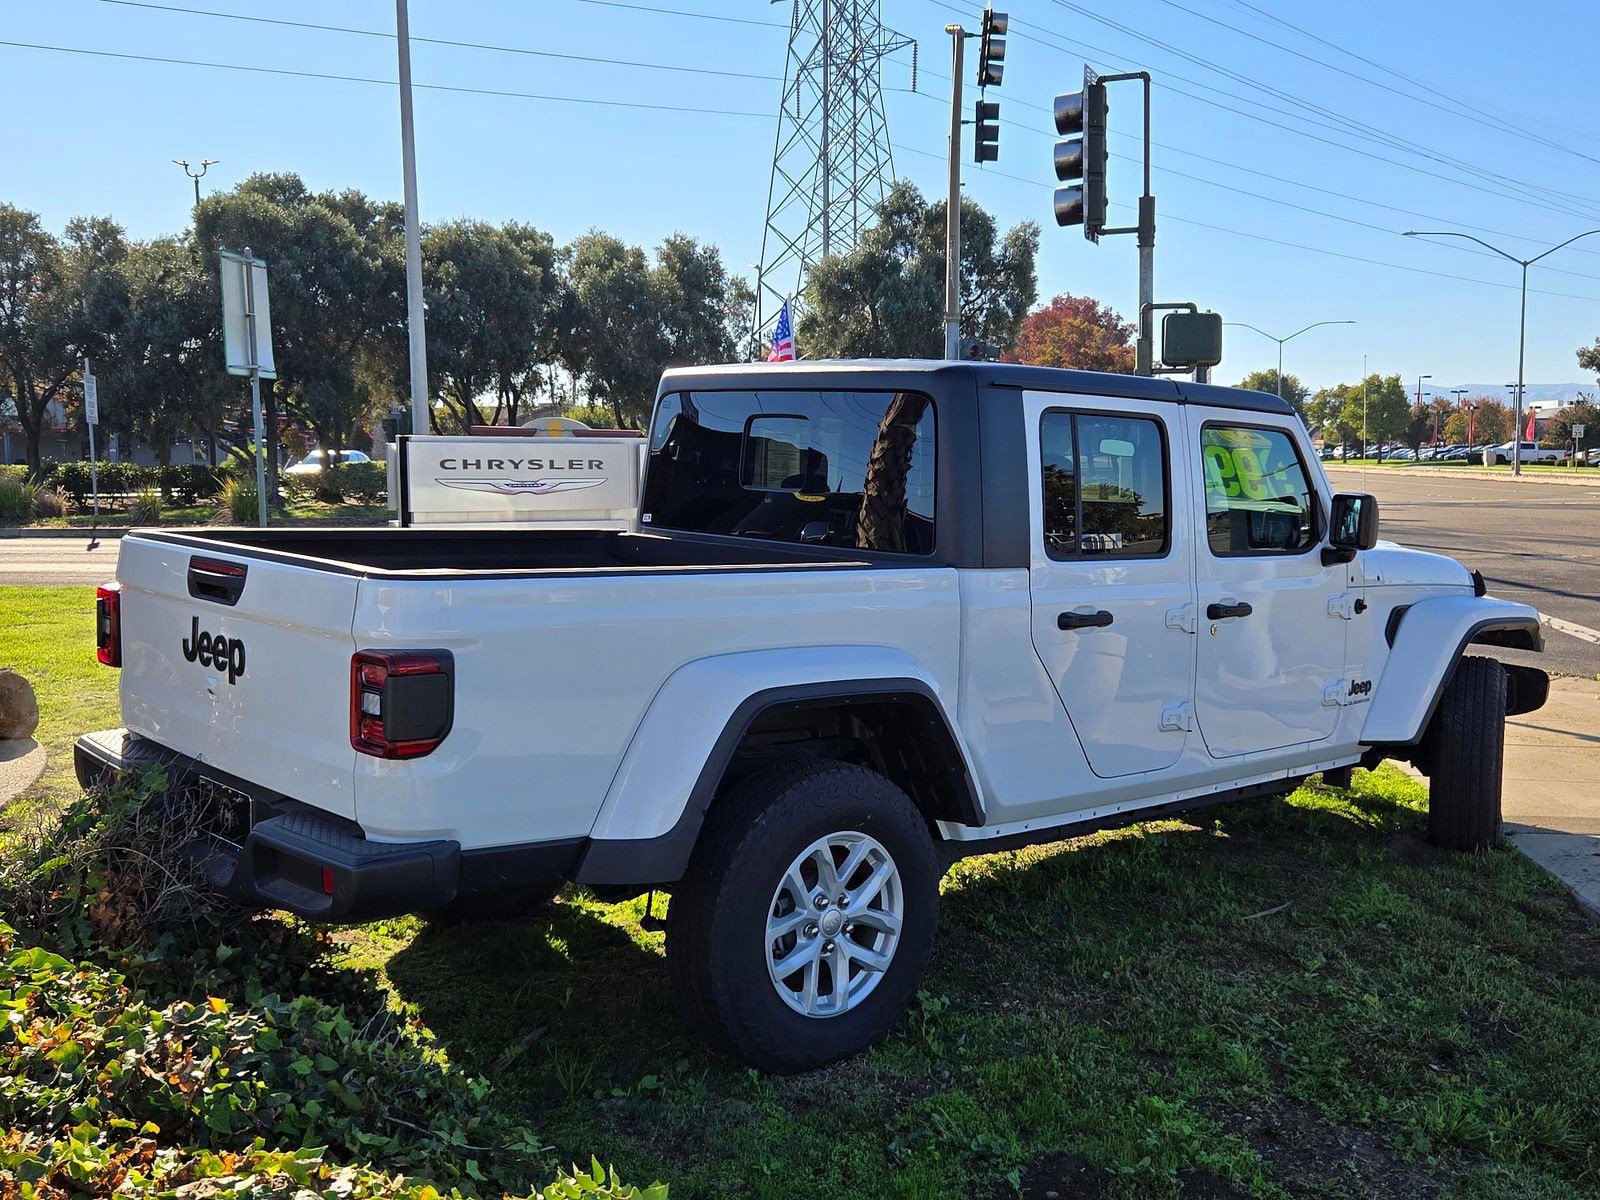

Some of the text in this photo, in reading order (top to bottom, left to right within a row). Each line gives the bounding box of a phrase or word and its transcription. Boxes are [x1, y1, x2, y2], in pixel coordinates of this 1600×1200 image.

[439, 458, 604, 470] CHRYSLER
[182, 616, 246, 685] Jeep
[1348, 679, 1372, 697] Jeep
